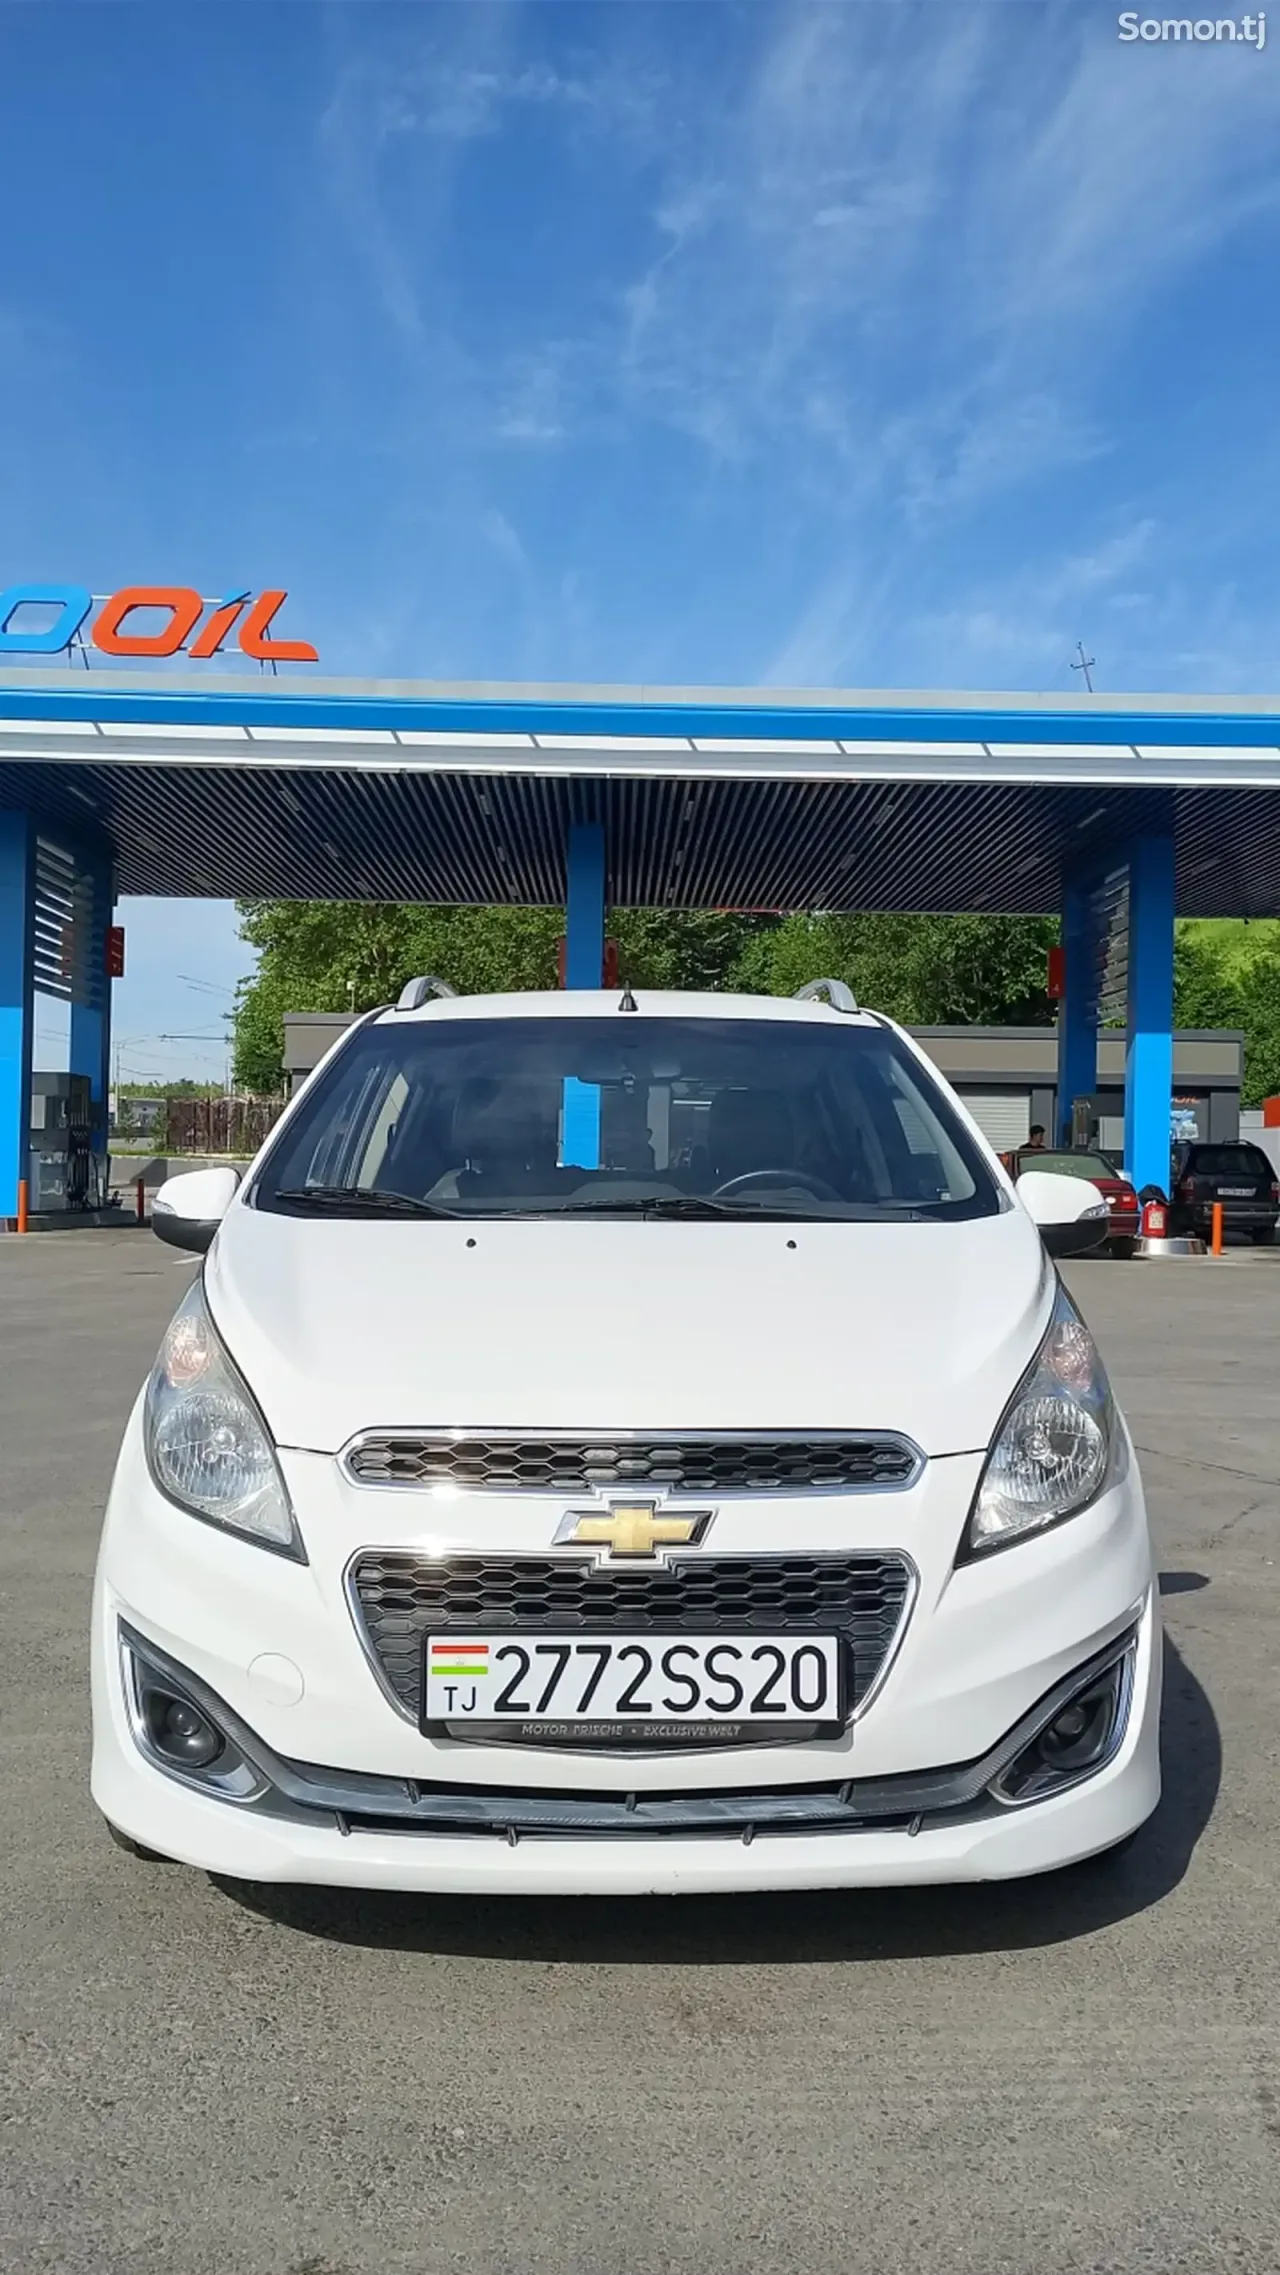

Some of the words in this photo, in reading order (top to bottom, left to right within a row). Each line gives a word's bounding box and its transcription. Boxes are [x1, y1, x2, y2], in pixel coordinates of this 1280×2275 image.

[493, 1644, 828, 1713] 2772SS20
[443, 1686, 477, 1712] TJ
[521, 1723, 569, 1736] MOTOR
[643, 1724, 706, 1737] EXCLUSIVE
